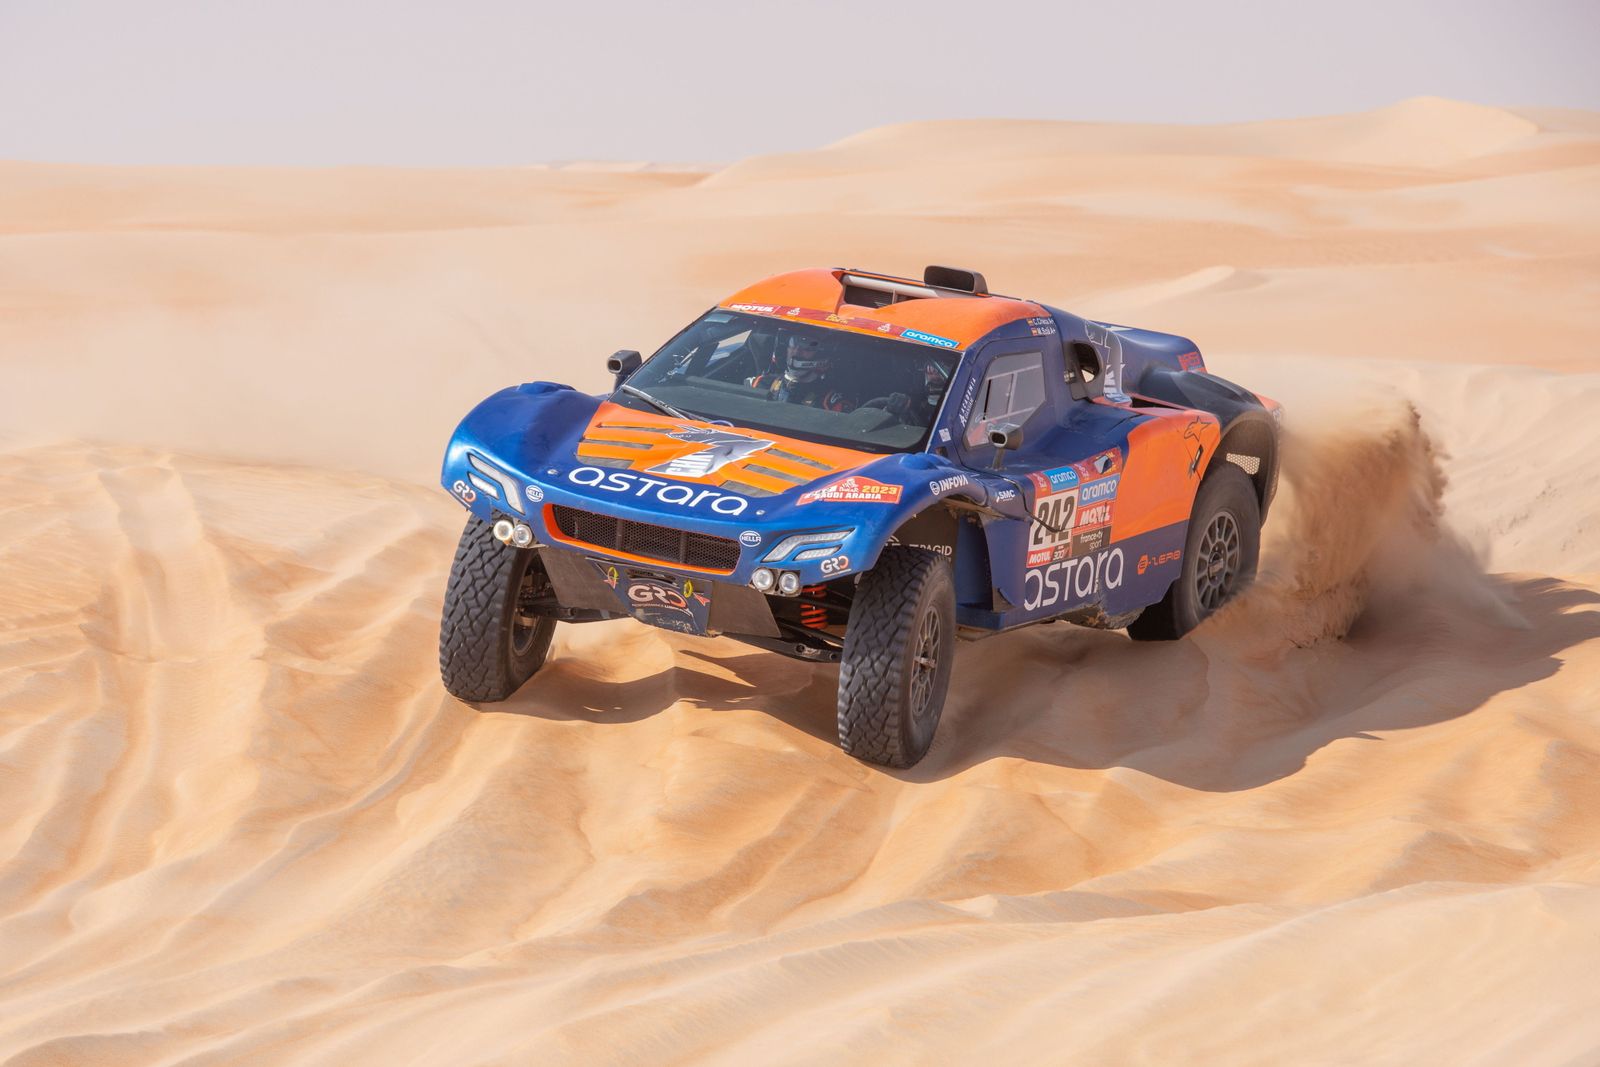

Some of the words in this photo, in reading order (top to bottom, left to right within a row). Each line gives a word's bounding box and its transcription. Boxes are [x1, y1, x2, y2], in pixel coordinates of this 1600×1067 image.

[730, 304, 774, 313] MOTUL
[906, 330, 954, 348] aramco
[1050, 471, 1077, 484] aramco
[568, 467, 748, 516] astara
[844, 492, 882, 500] ARABIA
[862, 485, 898, 495] 2023
[998, 489, 1016, 500] SMC
[1082, 479, 1117, 501] aramco
[1033, 495, 1075, 546] 242
[741, 534, 761, 543] HELLA
[820, 555, 849, 574] GRO
[1029, 551, 1051, 564] MOTUL
[1024, 547, 1124, 611] astara
[628, 584, 687, 609] GRO
